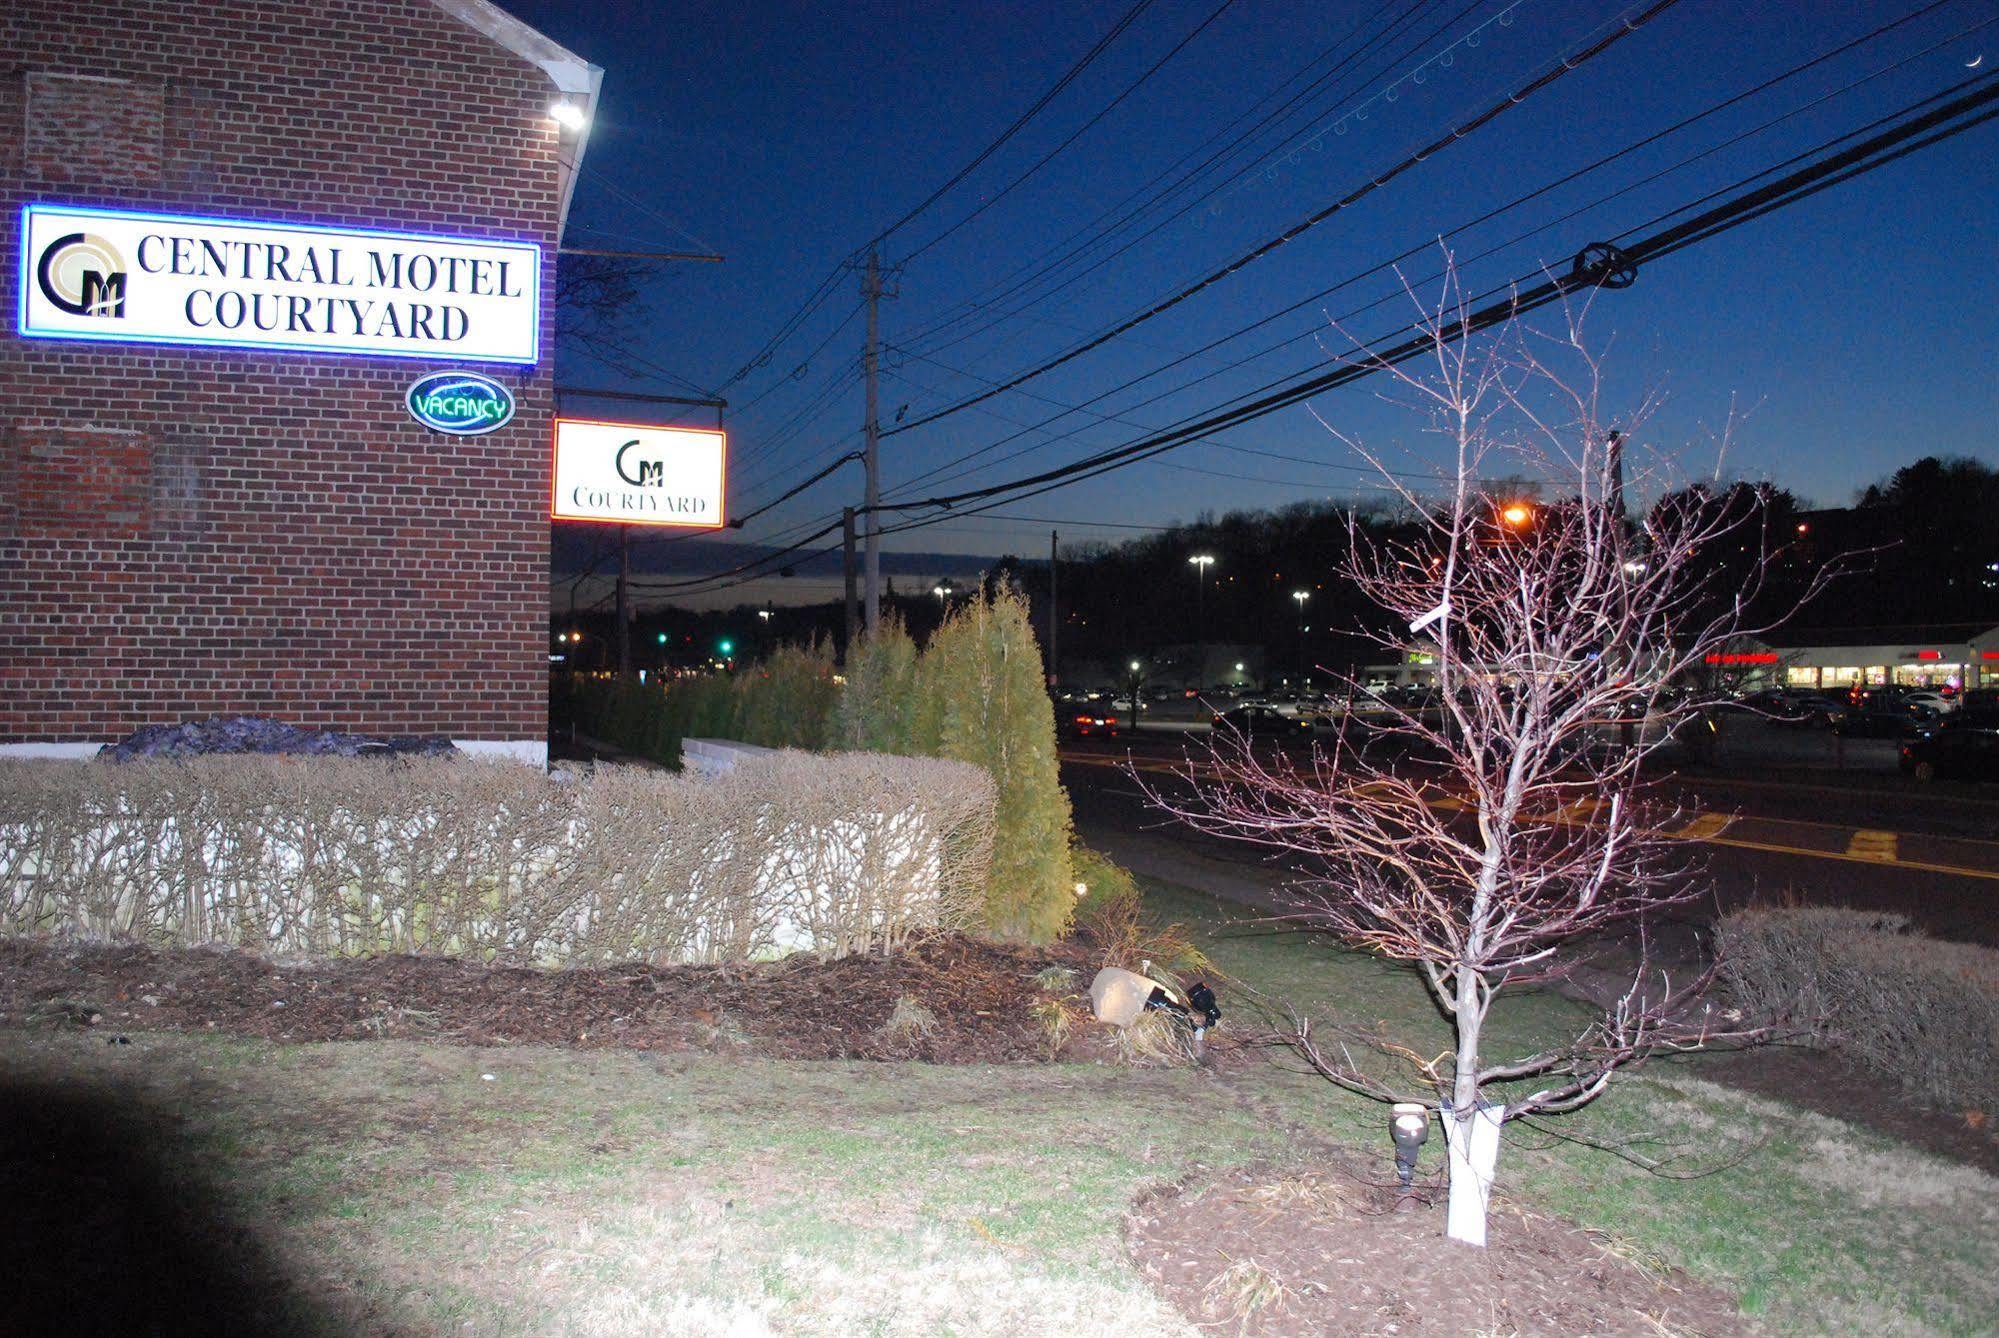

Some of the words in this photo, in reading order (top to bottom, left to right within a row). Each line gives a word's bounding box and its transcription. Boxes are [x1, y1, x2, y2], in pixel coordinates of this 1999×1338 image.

[137, 234, 354, 286] CENTRAL
[366, 251, 522, 298] MOTEL
[185, 289, 469, 341] COURTYARD
[416, 394, 506, 419] VACANCY
[573, 485, 706, 514] COURTYARD
